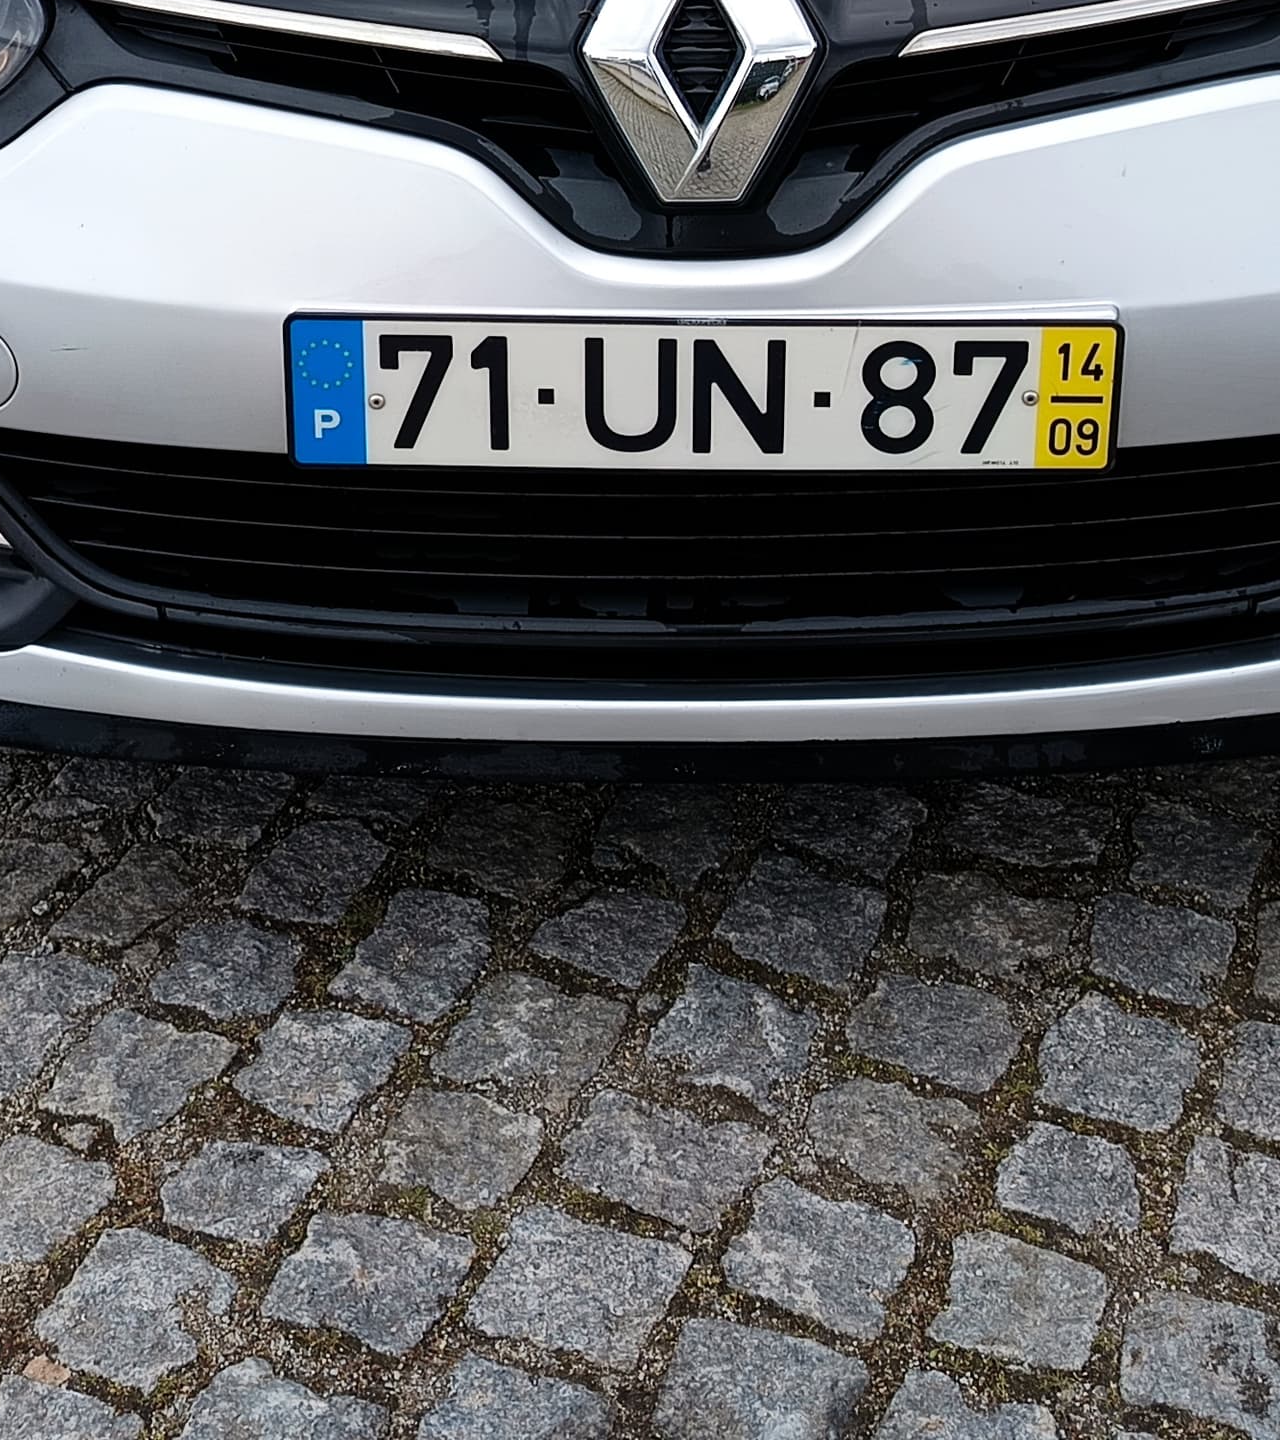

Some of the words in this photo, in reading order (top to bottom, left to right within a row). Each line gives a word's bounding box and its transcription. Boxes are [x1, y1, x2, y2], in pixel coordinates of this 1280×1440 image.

[1058, 343, 1103, 381] 14
[314, 409, 341, 439] P
[1049, 418, 1099, 455] 09
